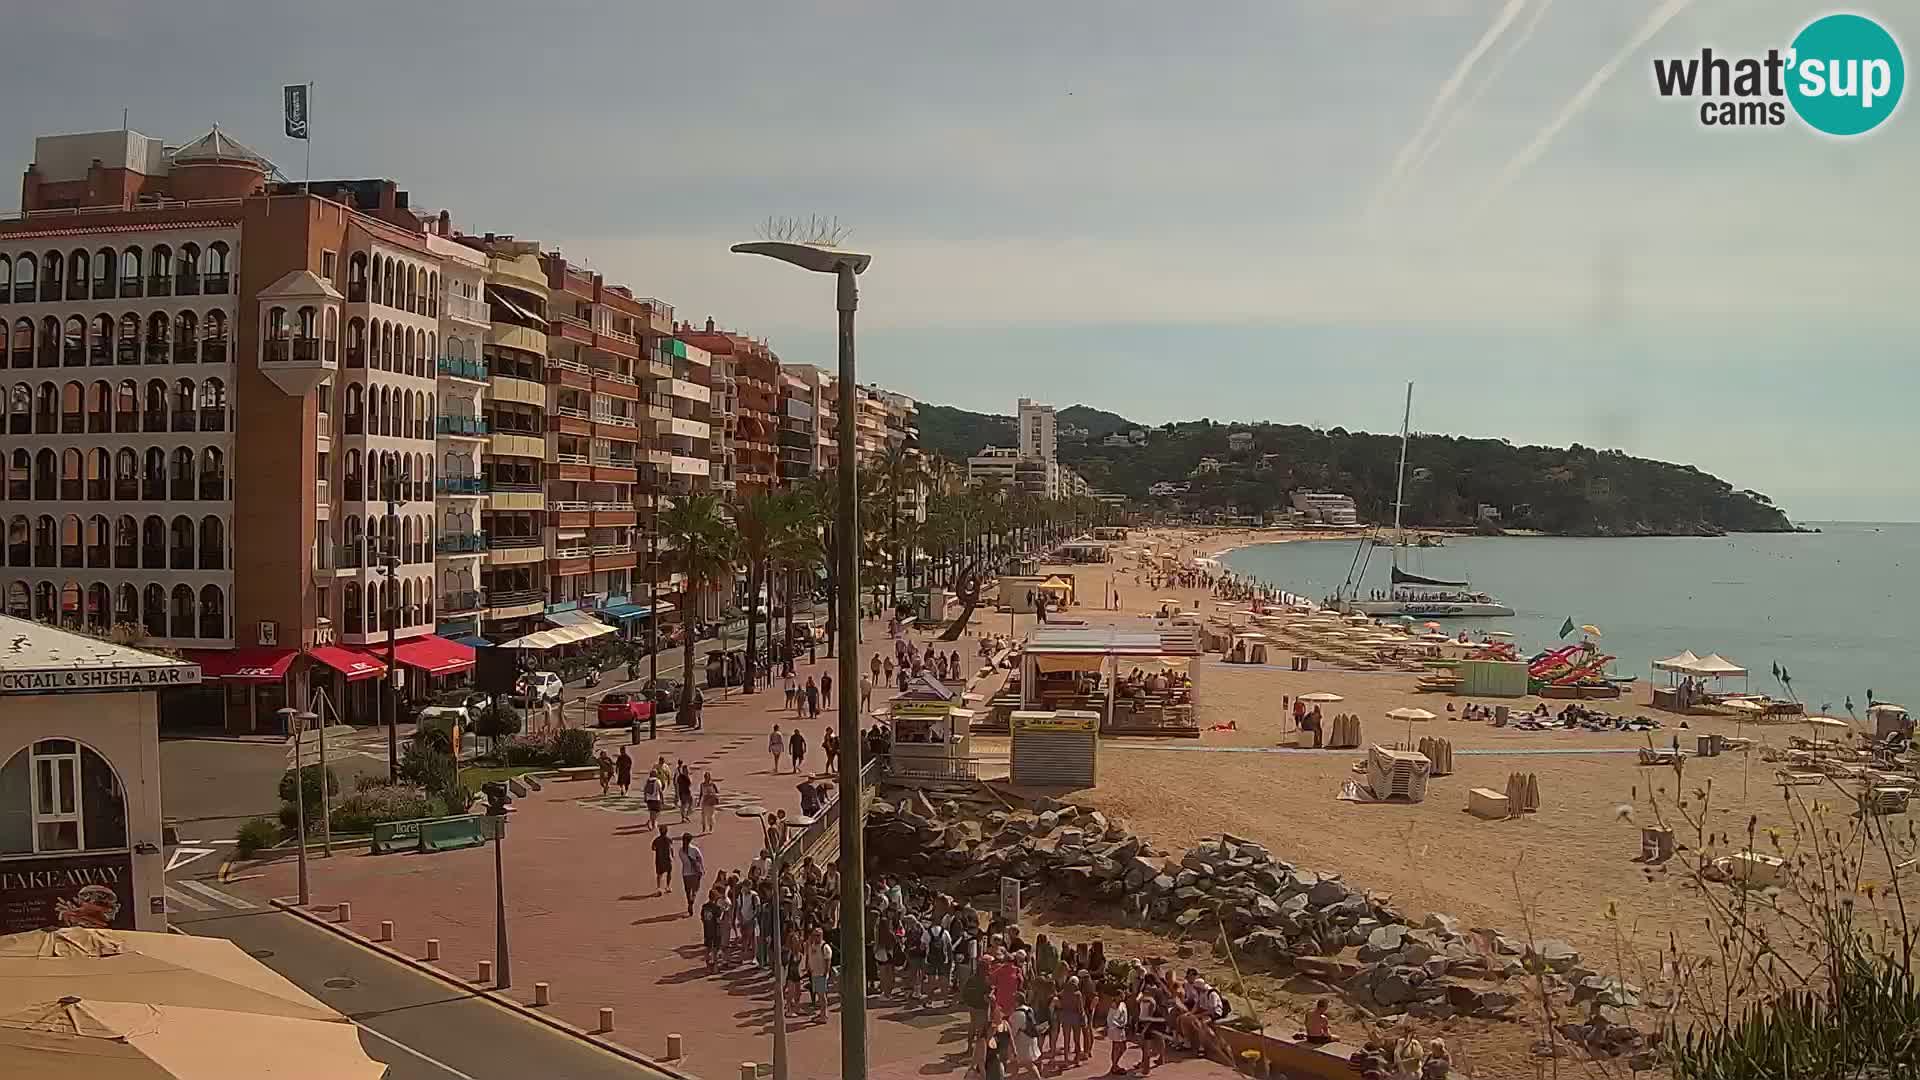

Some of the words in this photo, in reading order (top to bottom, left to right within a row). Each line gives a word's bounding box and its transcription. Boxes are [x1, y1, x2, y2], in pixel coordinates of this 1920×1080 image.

[65, 672, 76, 686] &
[81, 669, 143, 686] SHISHA
[149, 668, 181, 684] BAR
[236, 667, 273, 675] KFC
